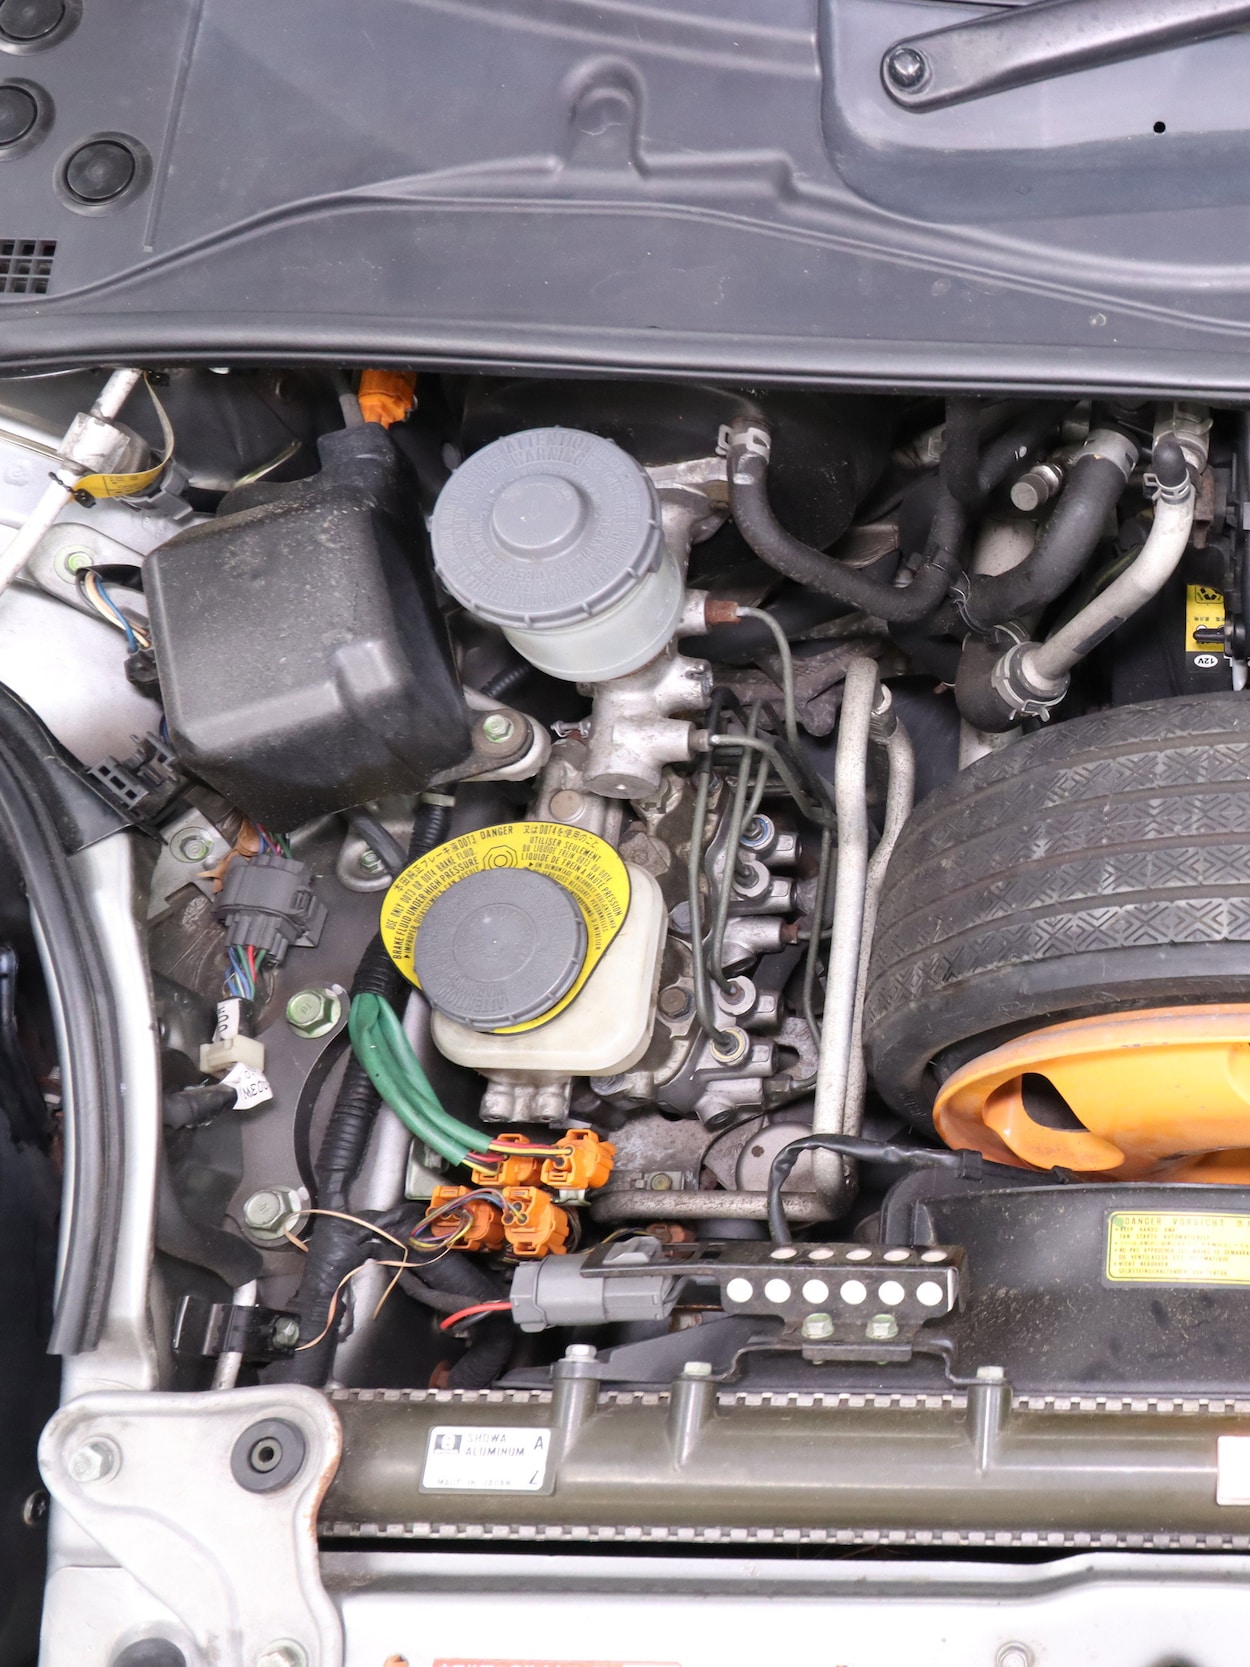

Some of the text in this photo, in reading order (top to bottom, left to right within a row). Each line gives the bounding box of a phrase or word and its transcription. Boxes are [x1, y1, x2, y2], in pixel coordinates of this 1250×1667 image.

[510, 446, 589, 467] WARNING
[478, 825, 513, 839] DANGER
[529, 834, 601, 863] UTILISER SEULEMENT
[532, 843, 556, 855] LIQUIDE
[557, 848, 575, 860] FREIN
[434, 855, 456, 872] BRAKE
[419, 867, 437, 883] DOT4
[410, 879, 424, 891] OR
[521, 851, 625, 916] LIQUIDE DE FREIN A HAUTE PRESSION
[399, 888, 416, 904] DOT3
[389, 903, 406, 918] ONLY
[390, 856, 479, 959] BRAKE FLUID UNDER HIGH PRESSURE
[384, 918, 398, 930] USE
[402, 924, 418, 953] IMPROPER
[1124, 1217, 1162, 1226] DANGER
[466, 1433, 507, 1444] SHOWA
[533, 1435, 544, 1450] A
[464, 1446, 525, 1456] ALUMINUM
